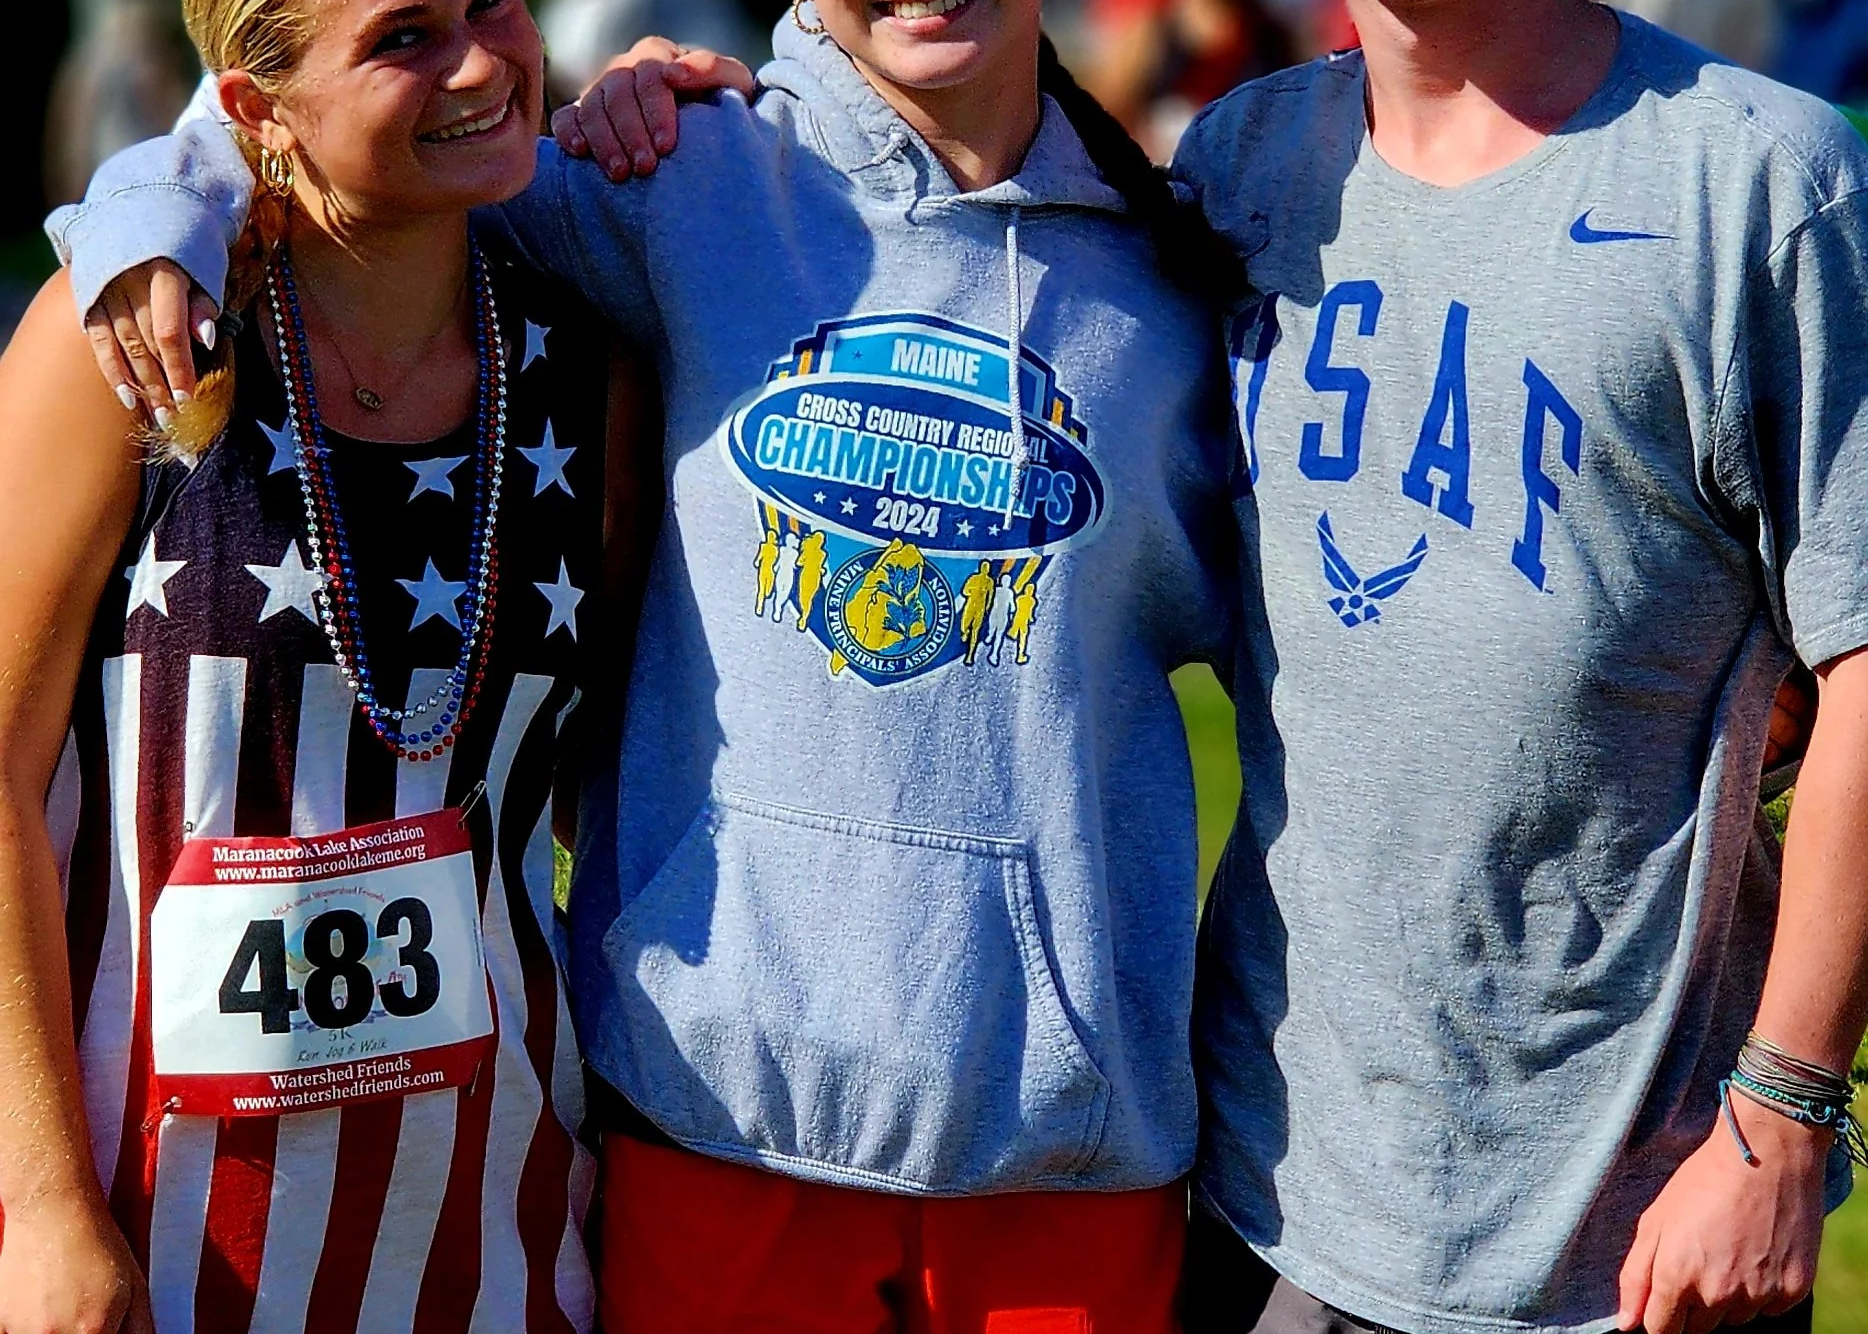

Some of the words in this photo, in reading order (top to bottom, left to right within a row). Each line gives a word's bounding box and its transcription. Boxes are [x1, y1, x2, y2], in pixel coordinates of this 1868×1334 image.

[890, 338, 981, 387] MAINE
[796, 392, 862, 428] CROSS
[865, 405, 954, 444] COUNTRY
[958, 422, 1049, 464] REGIOAL
[871, 496, 941, 538] 2024
[828, 561, 865, 607] MAINE
[904, 576, 951, 670] ASSOCIATION
[212, 844, 316, 862] Maranacook
[314, 840, 348, 857] Lake
[350, 826, 424, 851] Association
[214, 844, 426, 881] www.maranacooklakeme.org
[218, 897, 441, 1035] 483
[233, 1071, 445, 1111] www.watershedfriends.com
[270, 1065, 353, 1090] Watershed
[357, 1057, 412, 1078] Friends
